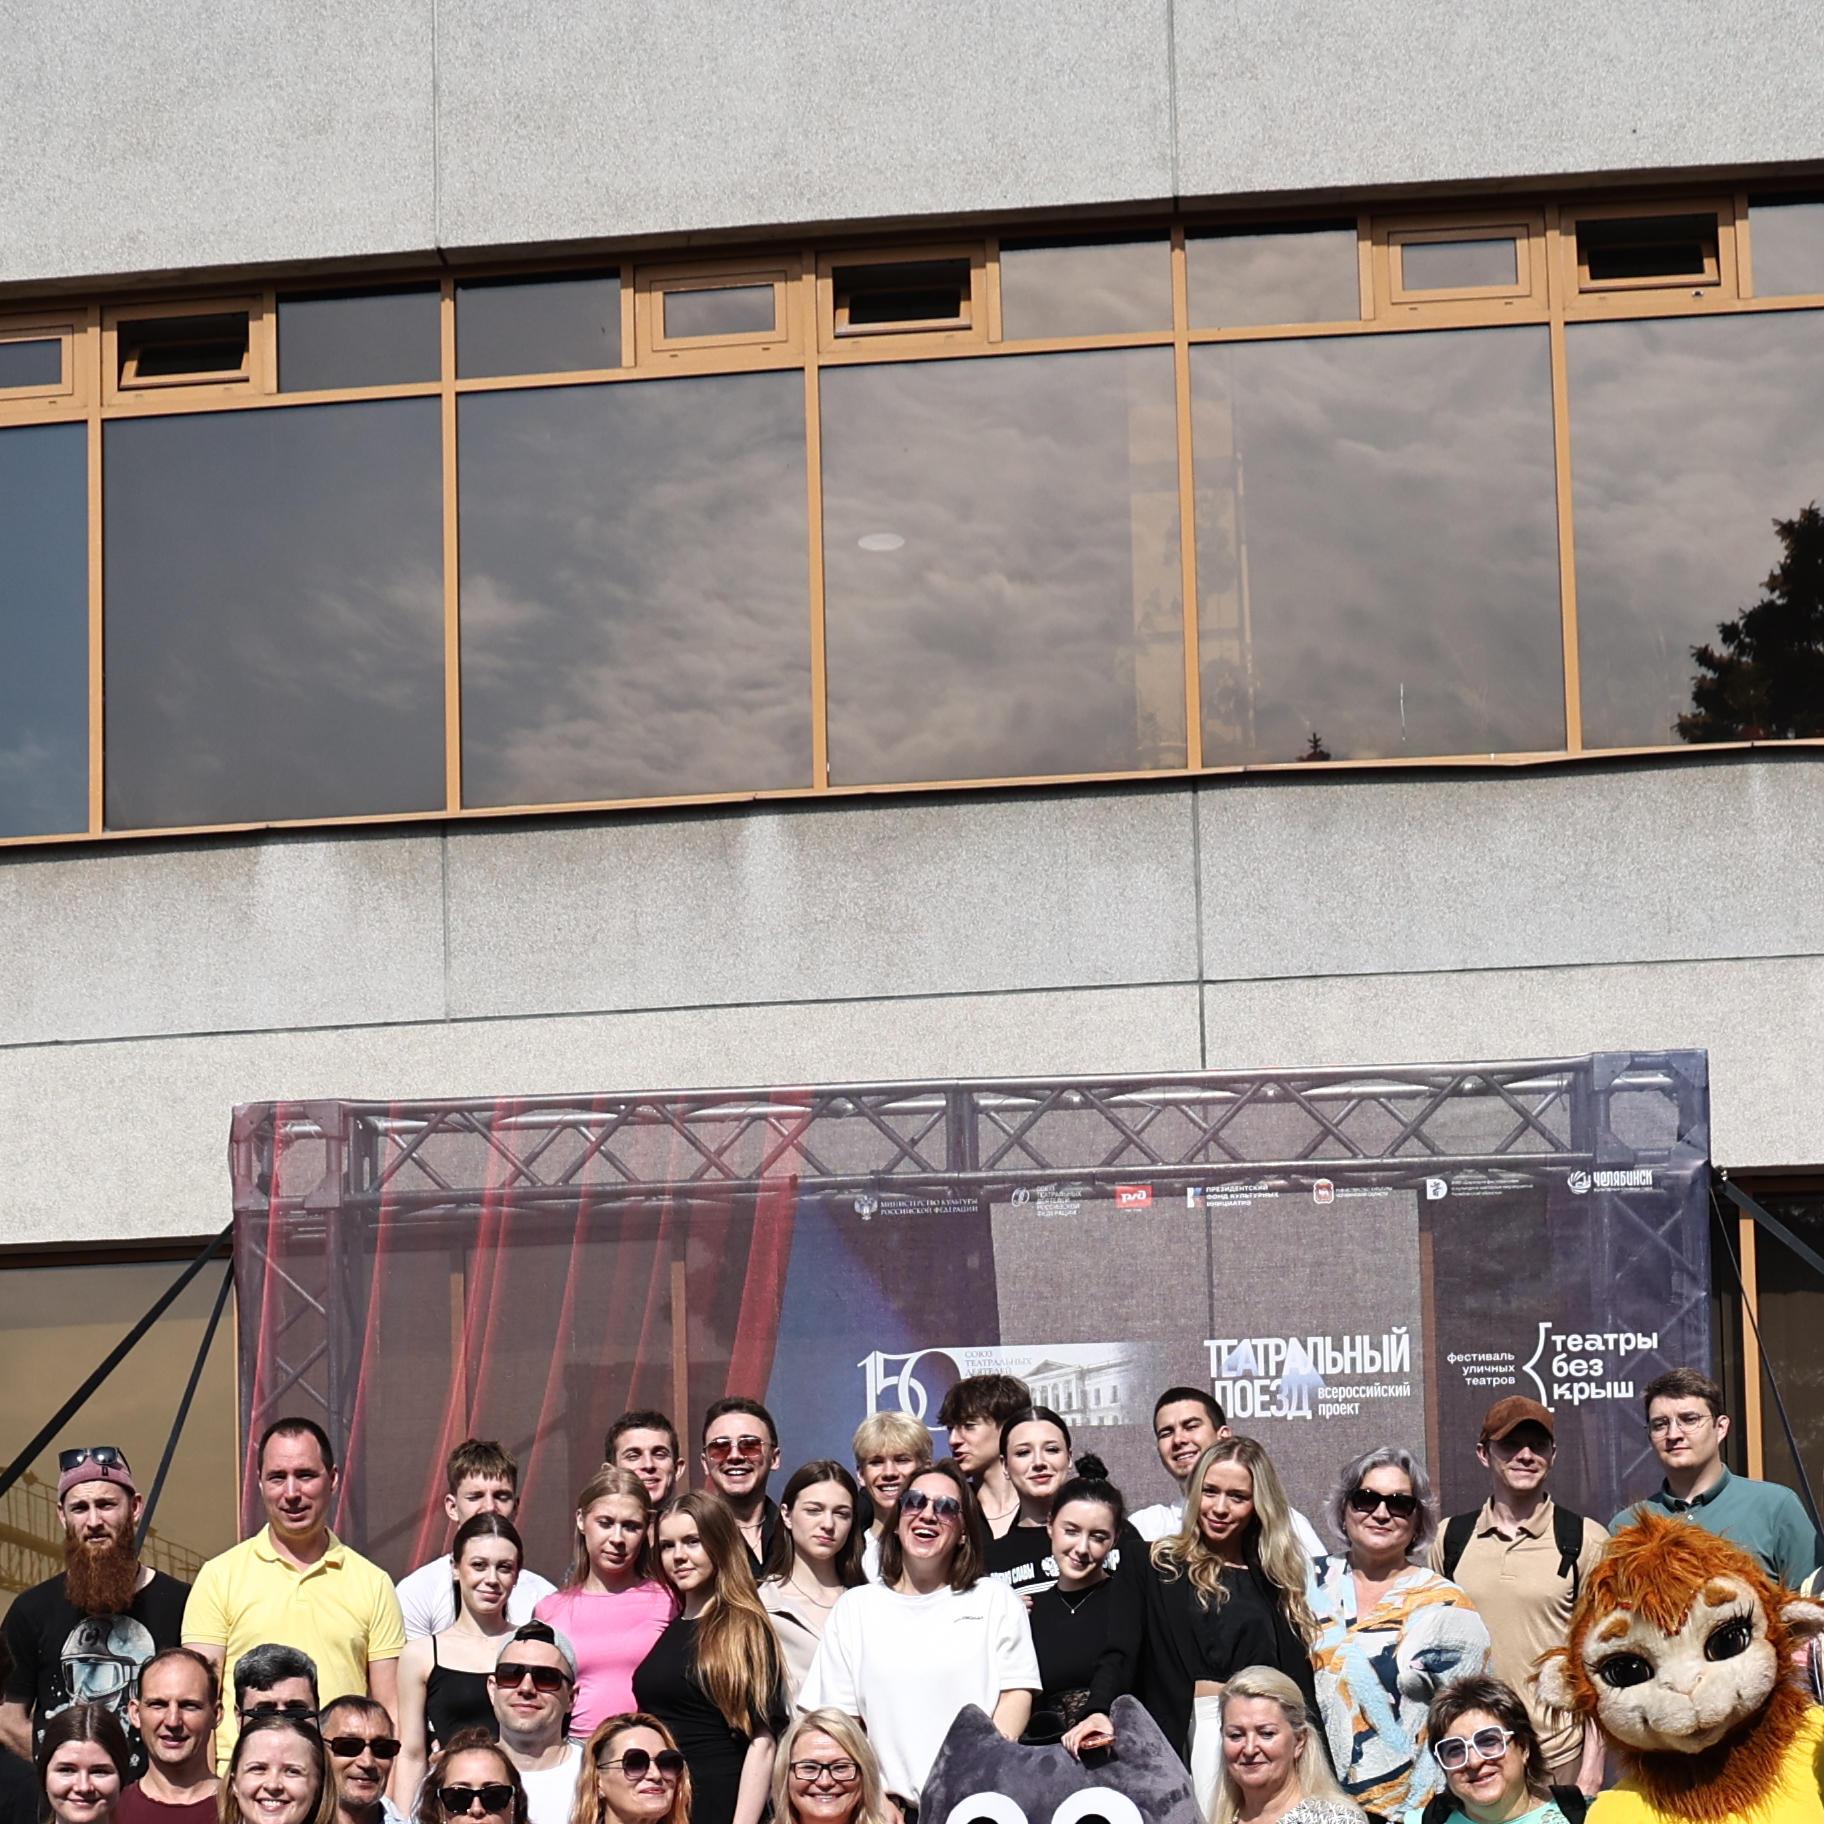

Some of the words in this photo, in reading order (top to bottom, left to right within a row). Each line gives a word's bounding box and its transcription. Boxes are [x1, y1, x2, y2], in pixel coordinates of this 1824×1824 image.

[1205, 1184, 1268, 1193] ПРЕЗИДЕНТСКИЙ
[880, 1206, 932, 1215] РОССИЙСКОЙ
[933, 1205, 979, 1214] ФЕДЕРАЦИИ
[1551, 1331, 1658, 1356] театры
[964, 1350, 993, 1358] СОЮЗ
[1203, 1326, 1411, 1378] ТЕАТРАЛЬНЫЙ
[1446, 1352, 1515, 1364] фестиваль
[964, 1357, 1032, 1367] ТЕАТРАЛЬНЫХ
[1552, 1353, 1604, 1378] без
[1462, 1364, 1516, 1376] уличных
[1465, 1376, 1516, 1387] театров
[1318, 1381, 1411, 1402] всероссийский
[1552, 1380, 1634, 1406] крыш
[1214, 1378, 1313, 1421] ПОЕЗД
[1318, 1402, 1360, 1419] проект
